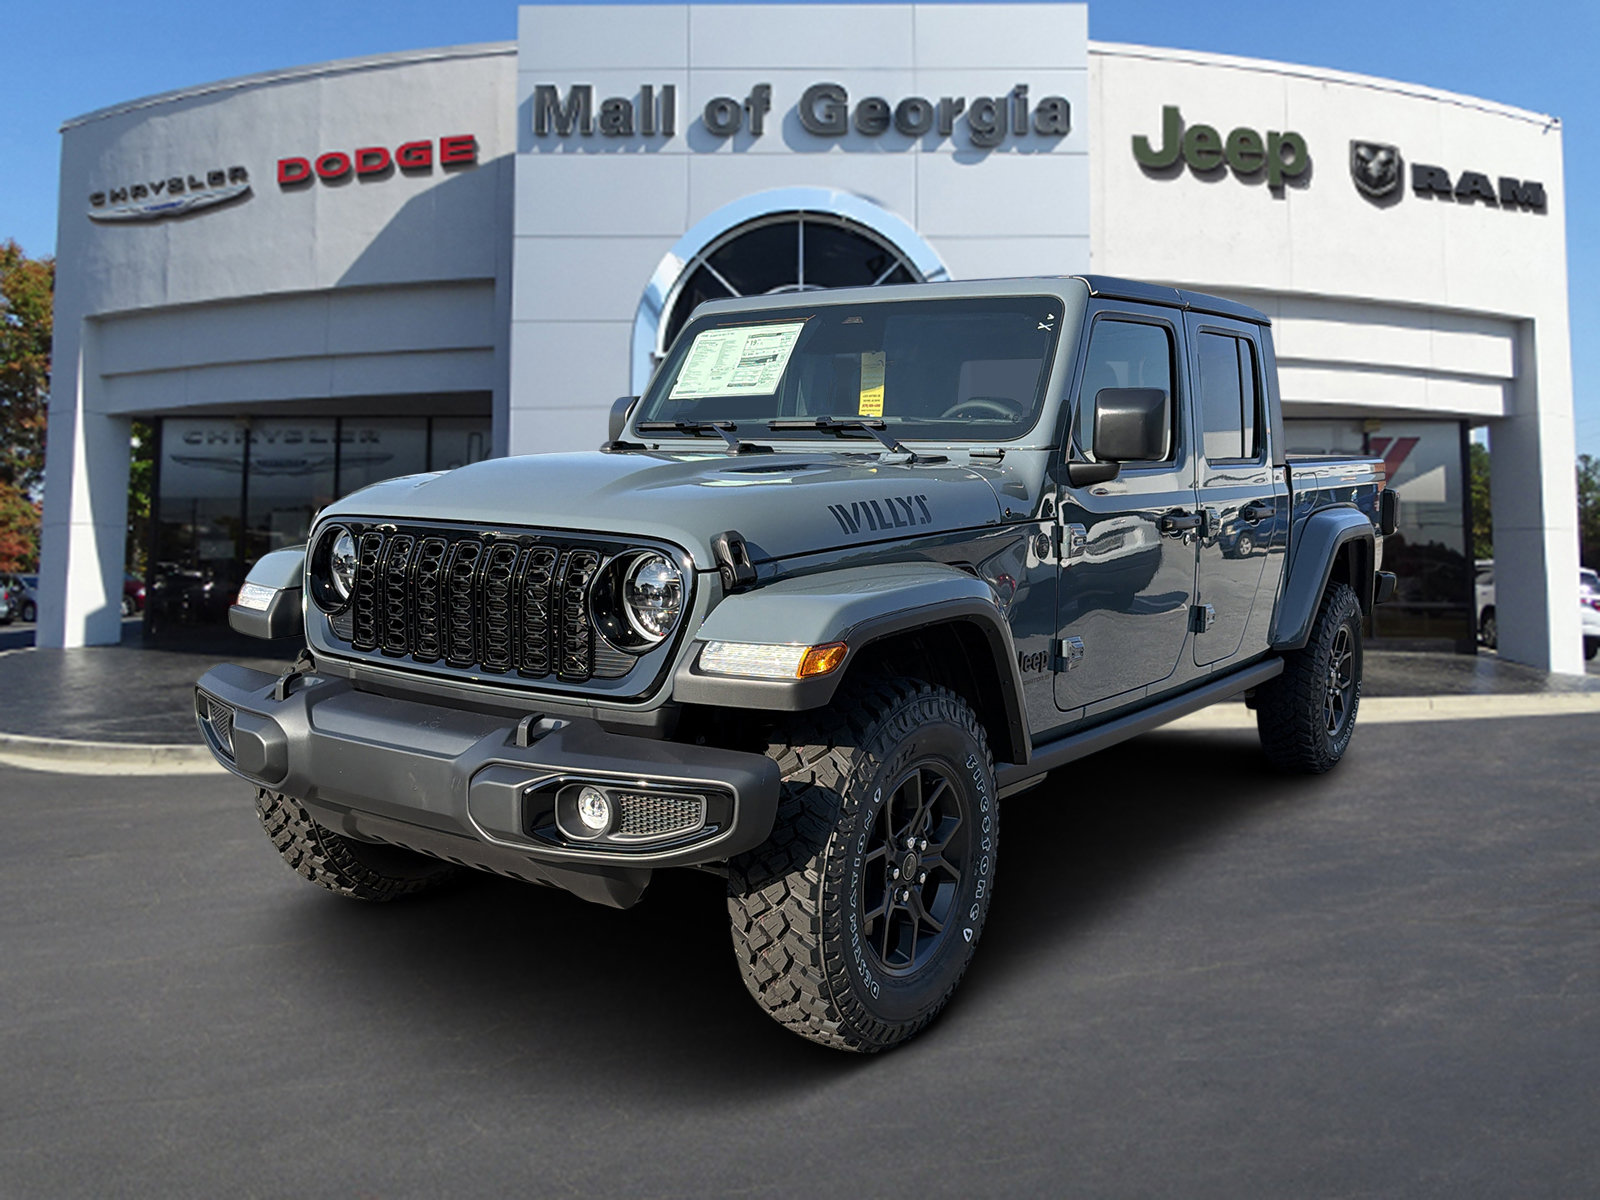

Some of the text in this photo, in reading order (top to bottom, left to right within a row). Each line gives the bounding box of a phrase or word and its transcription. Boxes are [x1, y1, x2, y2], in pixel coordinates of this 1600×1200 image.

[532, 82, 1072, 149] Mall of Georgia
[276, 134, 478, 187] DODGE
[1130, 104, 1310, 195] Jeep
[88, 166, 250, 208] CHRYSLER
[1411, 162, 1548, 215] RAM
[827, 494, 933, 536] WILLYS
[849, 808, 881, 1000] DESTINATION
